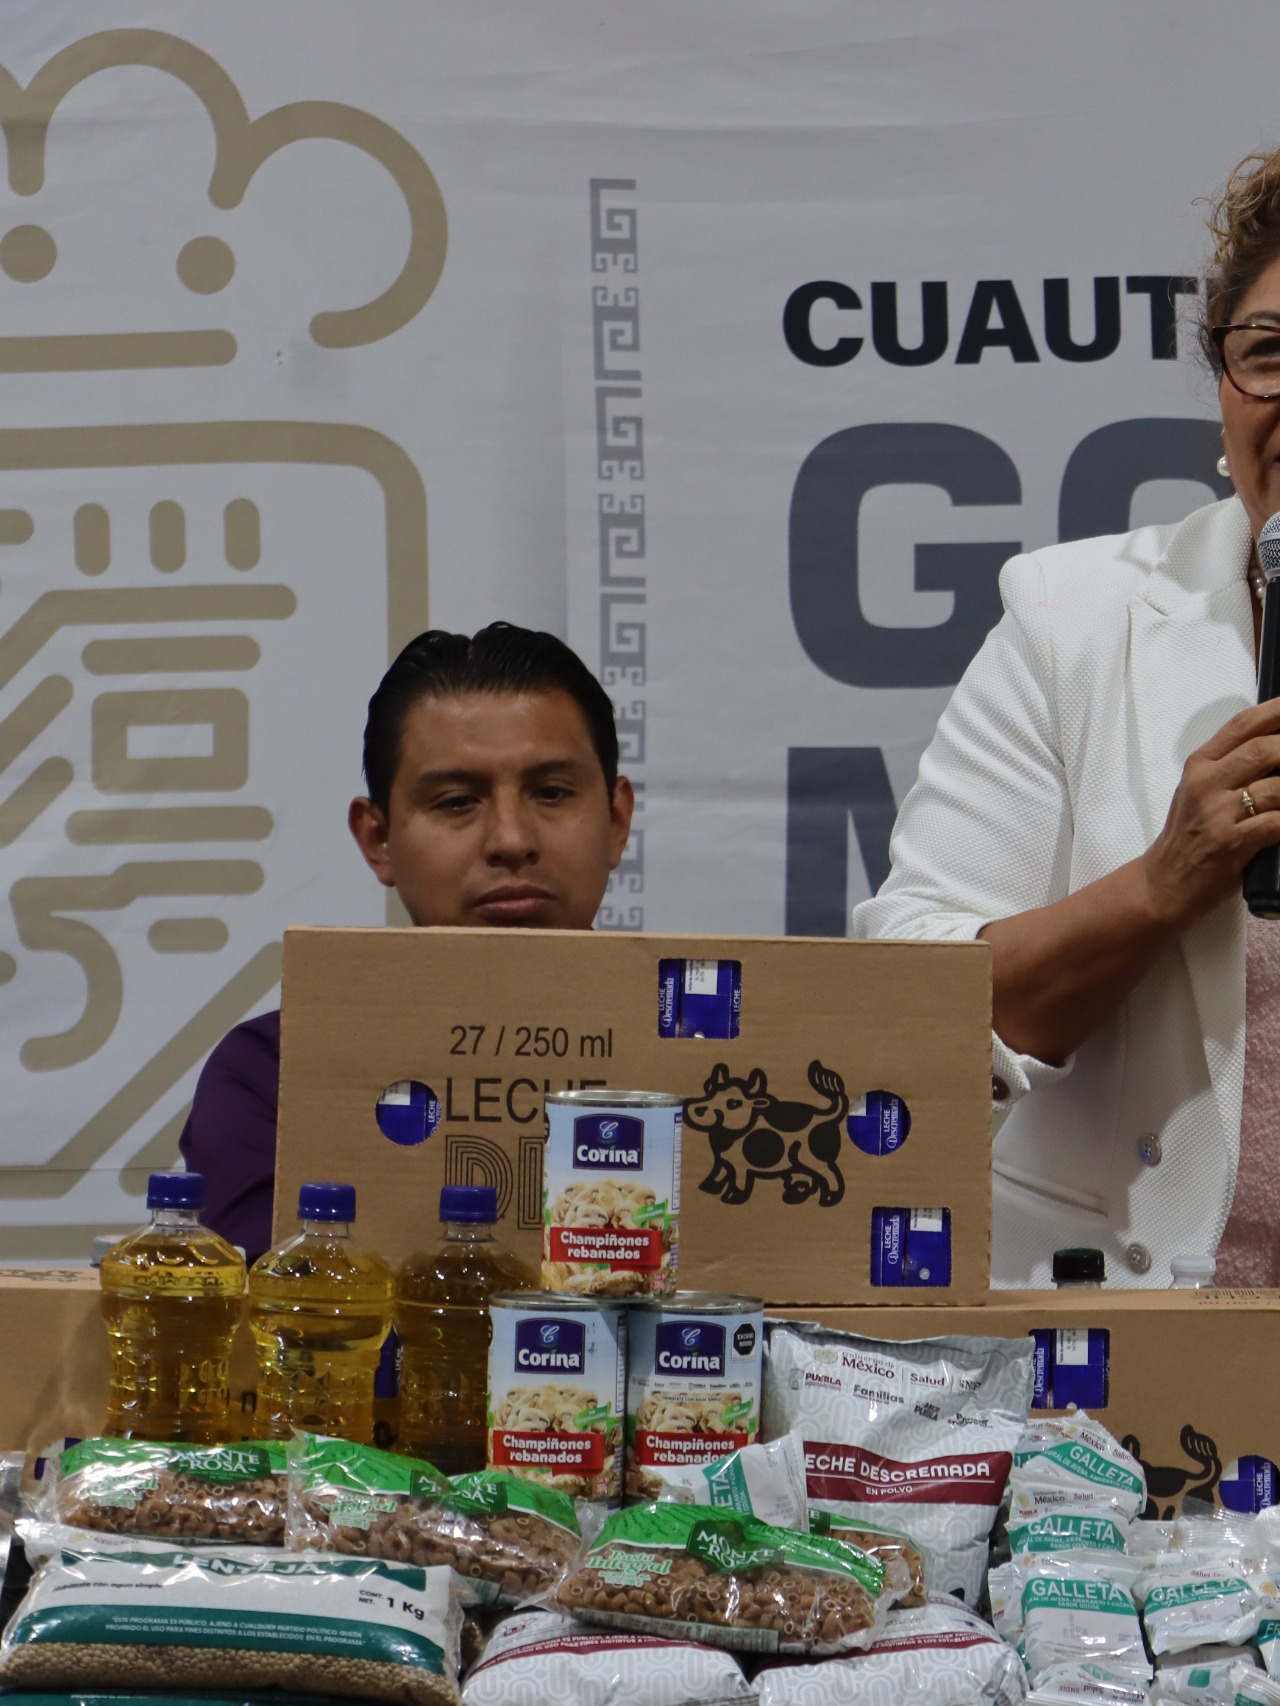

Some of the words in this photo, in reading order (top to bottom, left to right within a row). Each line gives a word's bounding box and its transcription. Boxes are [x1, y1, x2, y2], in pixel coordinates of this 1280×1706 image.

[450, 1025, 486, 1056] 27
[495, 1026, 506, 1057] /
[514, 1026, 569, 1058] 250
[580, 1028, 613, 1058] ml
[446, 1077, 607, 1124] LEC
[576, 1144, 640, 1165] Corina
[560, 1231, 650, 1248] Champiñones
[884, 1225, 892, 1249] LECHE
[567, 1246, 641, 1260] rebanados
[518, 1348, 581, 1369] Corina
[658, 1350, 722, 1371] Corina
[841, 1357, 895, 1379] México
[805, 1372, 842, 1387] PUEBLA
[910, 1372, 945, 1387] Salud
[853, 1384, 905, 1404] Familias
[502, 1434, 592, 1451] Champiñones
[645, 1435, 735, 1452] Champiñones
[1080, 1431, 1105, 1452] México
[173, 1448, 260, 1465] MONTE
[510, 1450, 583, 1464] rebanados
[653, 1450, 728, 1464] rebanado
[1069, 1445, 1134, 1486] GALLETA
[805, 1454, 856, 1473] ECHE
[860, 1460, 990, 1483] DESCREMADA
[866, 1486, 878, 1496] EN
[880, 1486, 913, 1496] POLVO
[1034, 1494, 1066, 1505] México
[1073, 1492, 1094, 1500] Salud
[1028, 1517, 1116, 1544] GALLETA
[173, 1554, 322, 1575] LENTEJA
[586, 1556, 673, 1575] Integral
[610, 1550, 655, 1562] Pasta
[1031, 1579, 1123, 1601] GALLETA
[359, 1589, 384, 1600] CONT.
[387, 1597, 395, 1608] 1
[402, 1601, 425, 1621] Kg
[130, 1617, 169, 1625] PROGRAMA
[239, 1622, 276, 1631] CUALQUIER
[277, 1624, 306, 1632] PARTIDO
[339, 1629, 362, 1637] QUEDA
[151, 1625, 165, 1633] USO
[203, 1628, 236, 1636] DISTINTOS
[257, 1630, 304, 1641] ESTABLECIDOS
